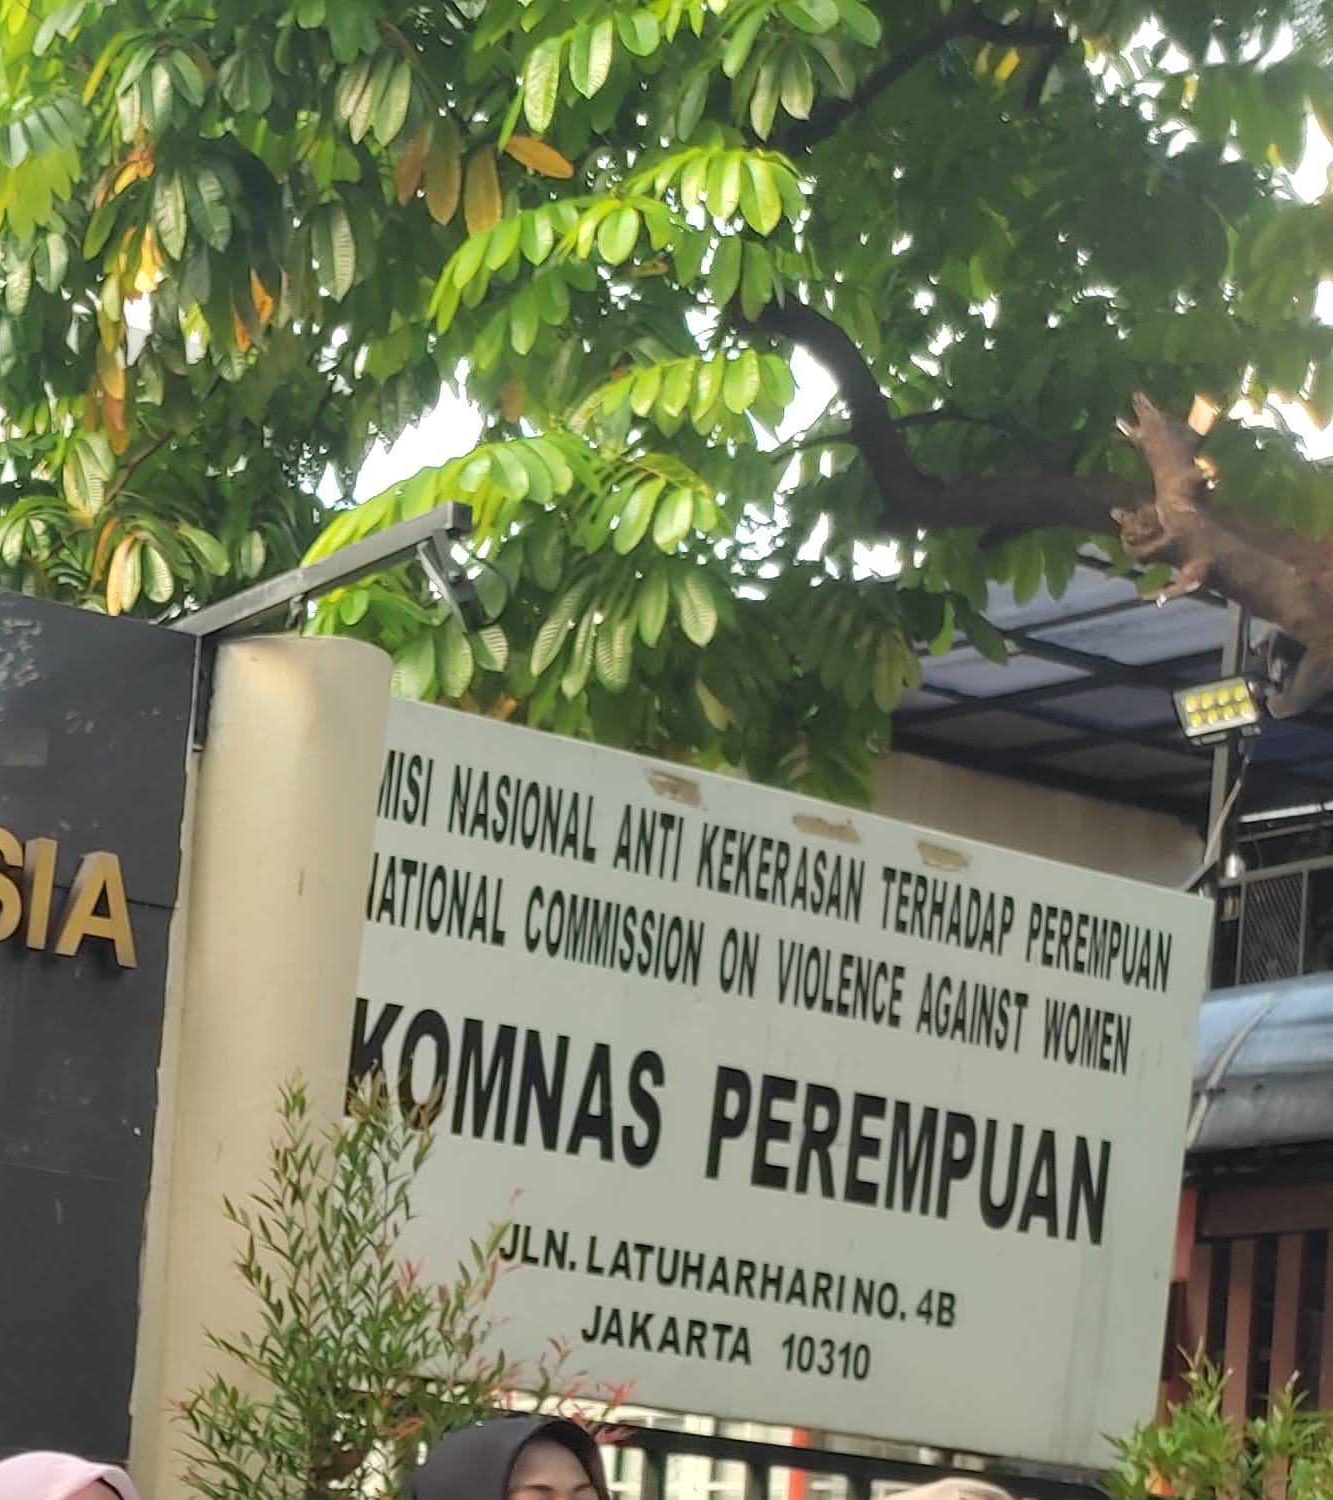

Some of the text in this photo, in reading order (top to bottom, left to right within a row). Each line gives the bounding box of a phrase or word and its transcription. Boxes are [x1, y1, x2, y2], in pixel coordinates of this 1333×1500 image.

[447, 764, 597, 864] NASIONAL
[613, 803, 684, 881] ANTI
[695, 823, 866, 924] KEKERASAN
[881, 866, 1016, 958] TERHADAP
[1026, 901, 1173, 992] PEREMPUAN
[525, 885, 703, 985] COMMISSION
[719, 926, 758, 998] ON
[776, 938, 907, 1028] VIOLENCE
[916, 971, 1029, 1054] AGAINST
[1043, 997, 1132, 1075] WOMEN
[344, 997, 1112, 1246] KOMNAS PEREMPUAN
[498, 1224, 957, 1328] JLN. LATUHARHARI NO. 4B
[580, 1305, 872, 1381] JAKARTA 10310
